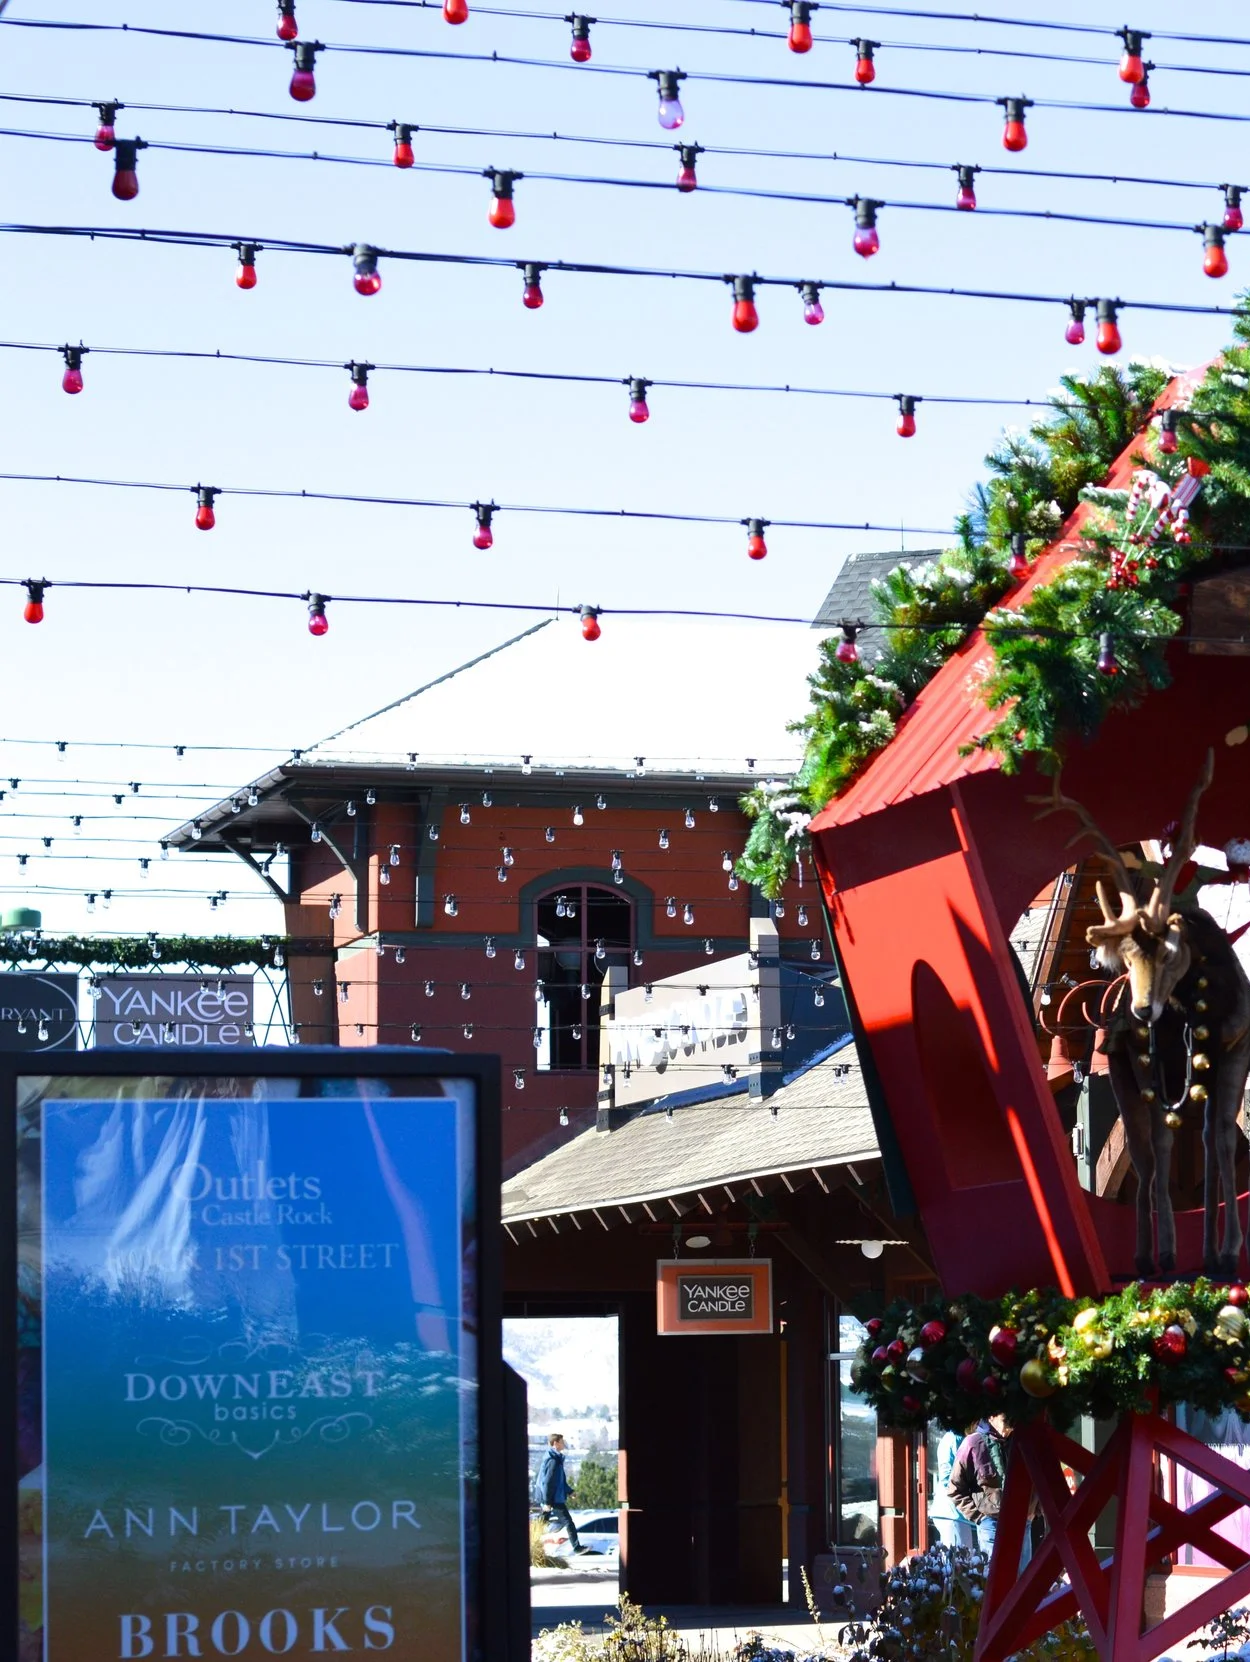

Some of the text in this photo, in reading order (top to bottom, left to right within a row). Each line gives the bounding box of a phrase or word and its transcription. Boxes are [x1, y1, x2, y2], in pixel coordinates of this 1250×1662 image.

[170, 1159, 322, 1200] Outlets
[201, 1203, 272, 1226] Castle
[276, 1202, 333, 1225] Rock
[215, 1244, 267, 1272] 1ST
[275, 1242, 400, 1271] STREET
[214, 1402, 297, 1422] basics
[84, 1500, 423, 1539] ANN TAYLOR
[170, 1555, 341, 1573] FACTORY STORE
[118, 1604, 396, 1658] BROOKS
